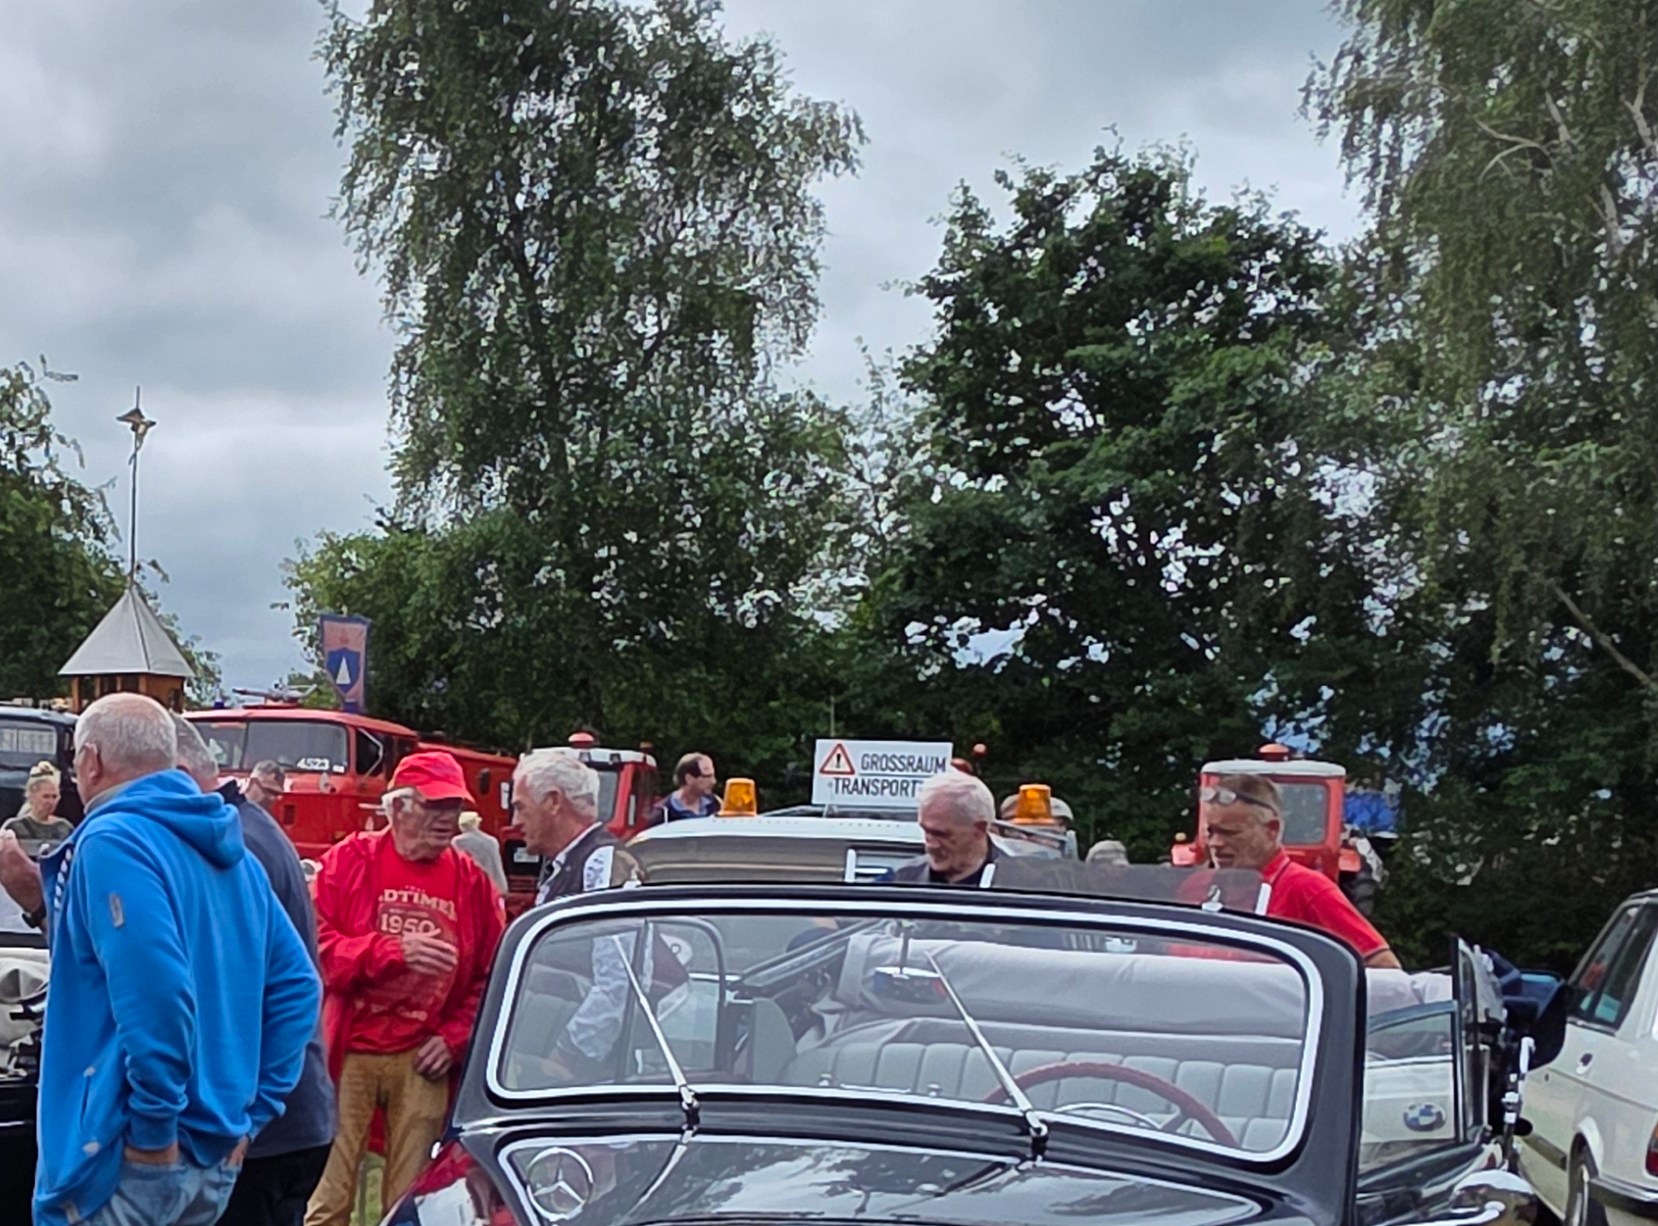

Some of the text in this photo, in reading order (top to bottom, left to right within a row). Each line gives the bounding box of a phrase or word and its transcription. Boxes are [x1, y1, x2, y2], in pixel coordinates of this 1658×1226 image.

[296, 757, 330, 770] 4523
[861, 754, 946, 774] GROSSRAUM
[380, 914, 438, 937] 1950
